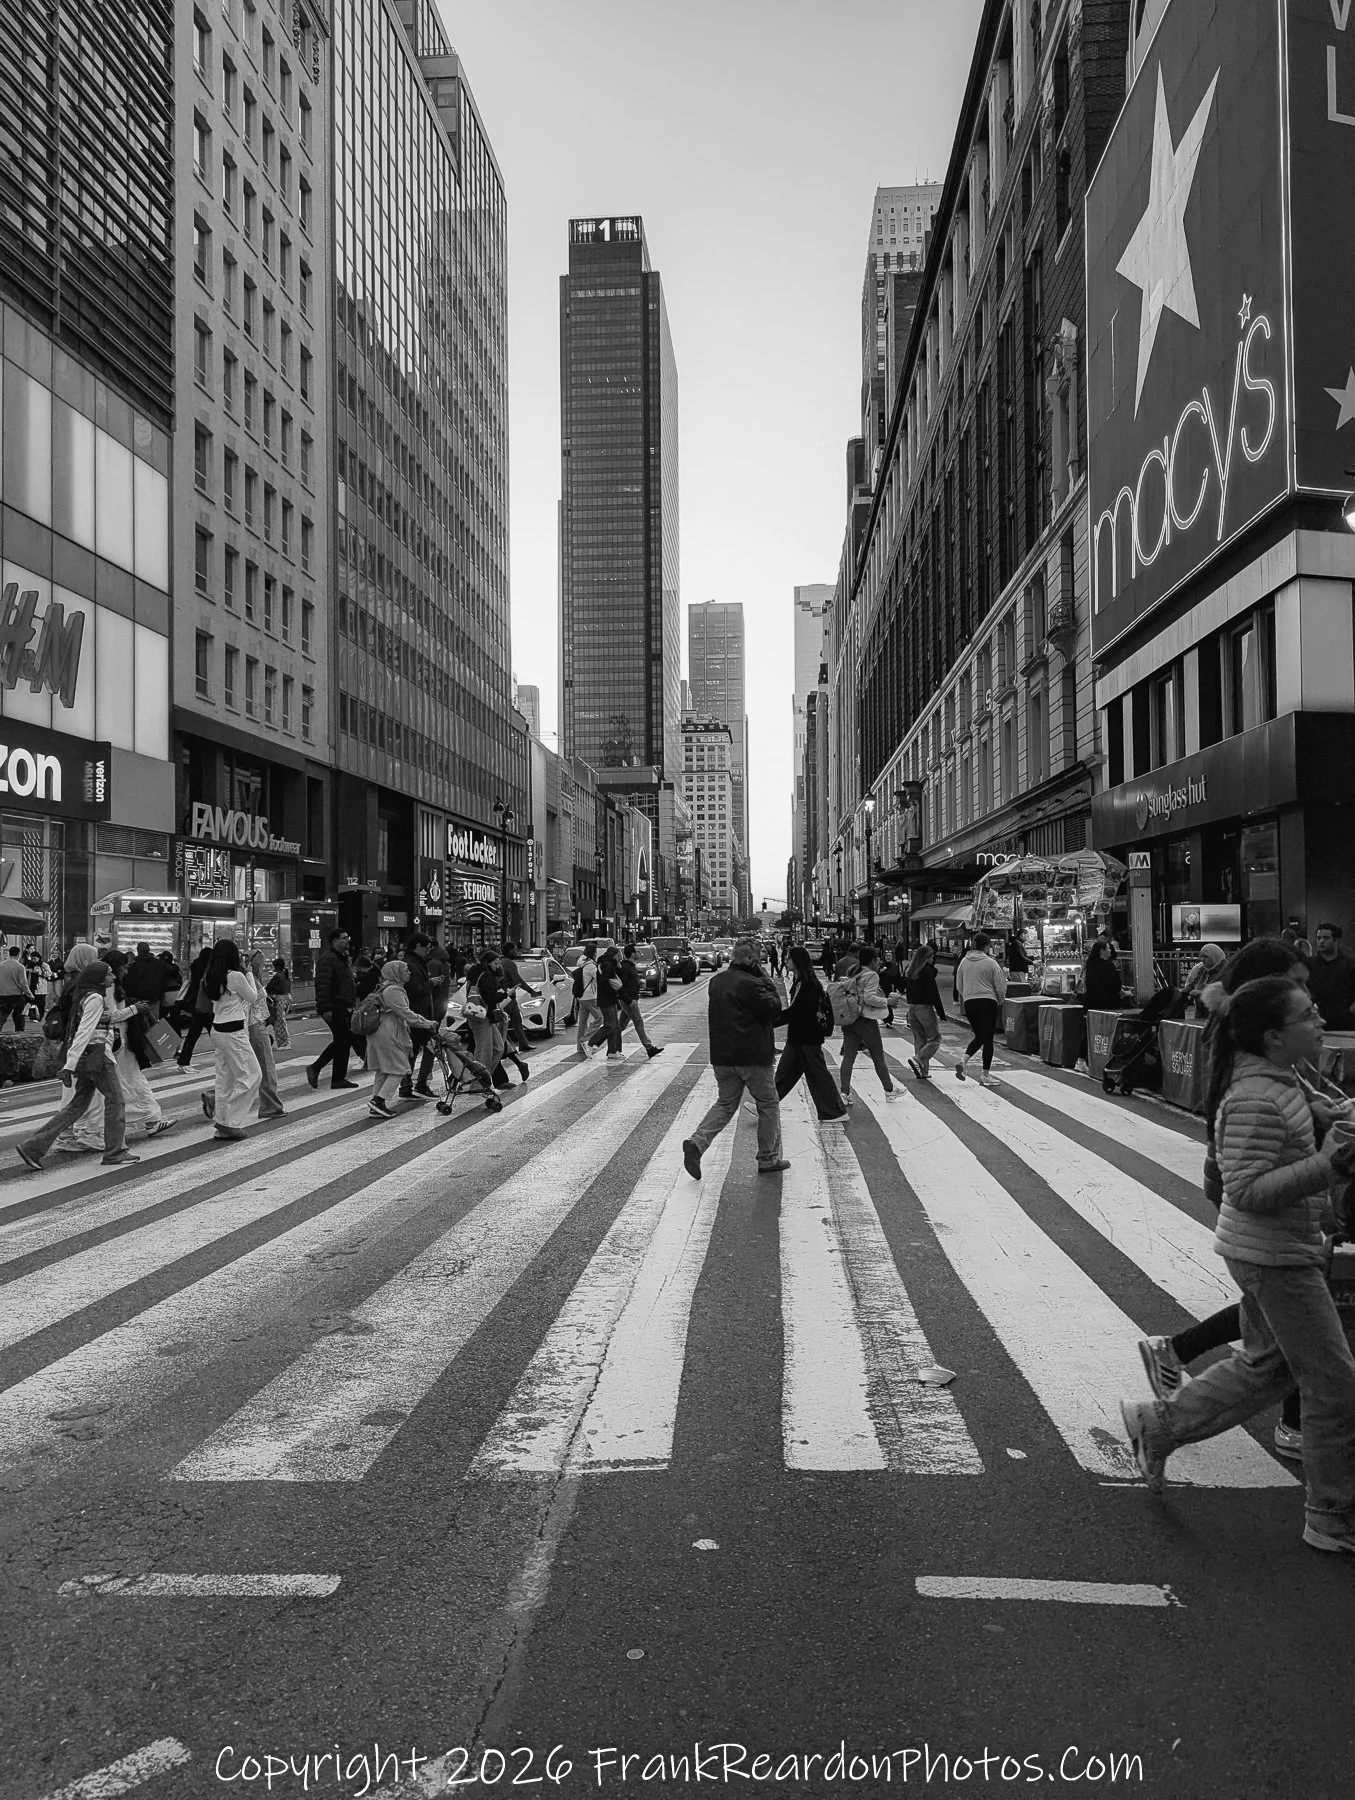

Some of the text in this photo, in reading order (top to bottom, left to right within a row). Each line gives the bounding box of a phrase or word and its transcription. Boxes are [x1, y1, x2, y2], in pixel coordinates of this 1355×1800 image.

[599, 220, 611, 241] 1
[0, 748, 61, 802] on
[96, 761, 106, 802] verizon
[1149, 774, 1207, 820] sunglass hut
[192, 801, 301, 854] FAMOUS footwear
[448, 824, 496, 864] Foot Locker
[175, 842, 183, 877] FAMOUS
[347, 877, 358, 885] 112
[463, 882, 496, 902] SEPHORA
